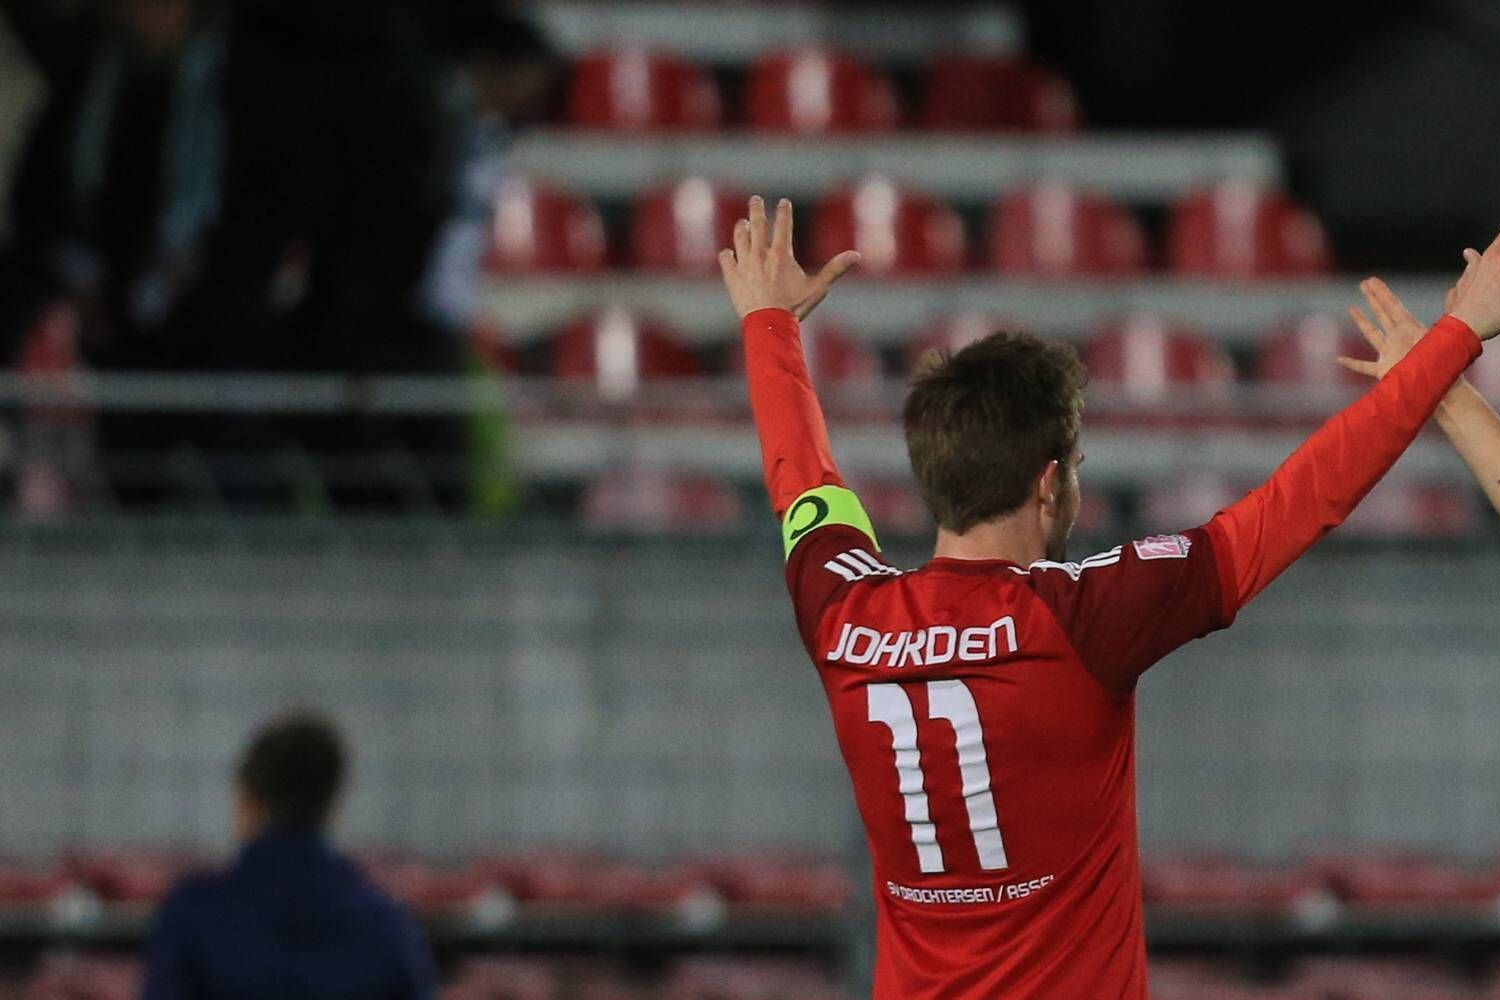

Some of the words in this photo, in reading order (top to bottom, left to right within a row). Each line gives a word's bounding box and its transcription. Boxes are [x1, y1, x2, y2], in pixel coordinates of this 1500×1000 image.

[827, 616, 1018, 668] JOHRDEN
[867, 679, 1009, 873] 11
[997, 884, 1004, 903] /
